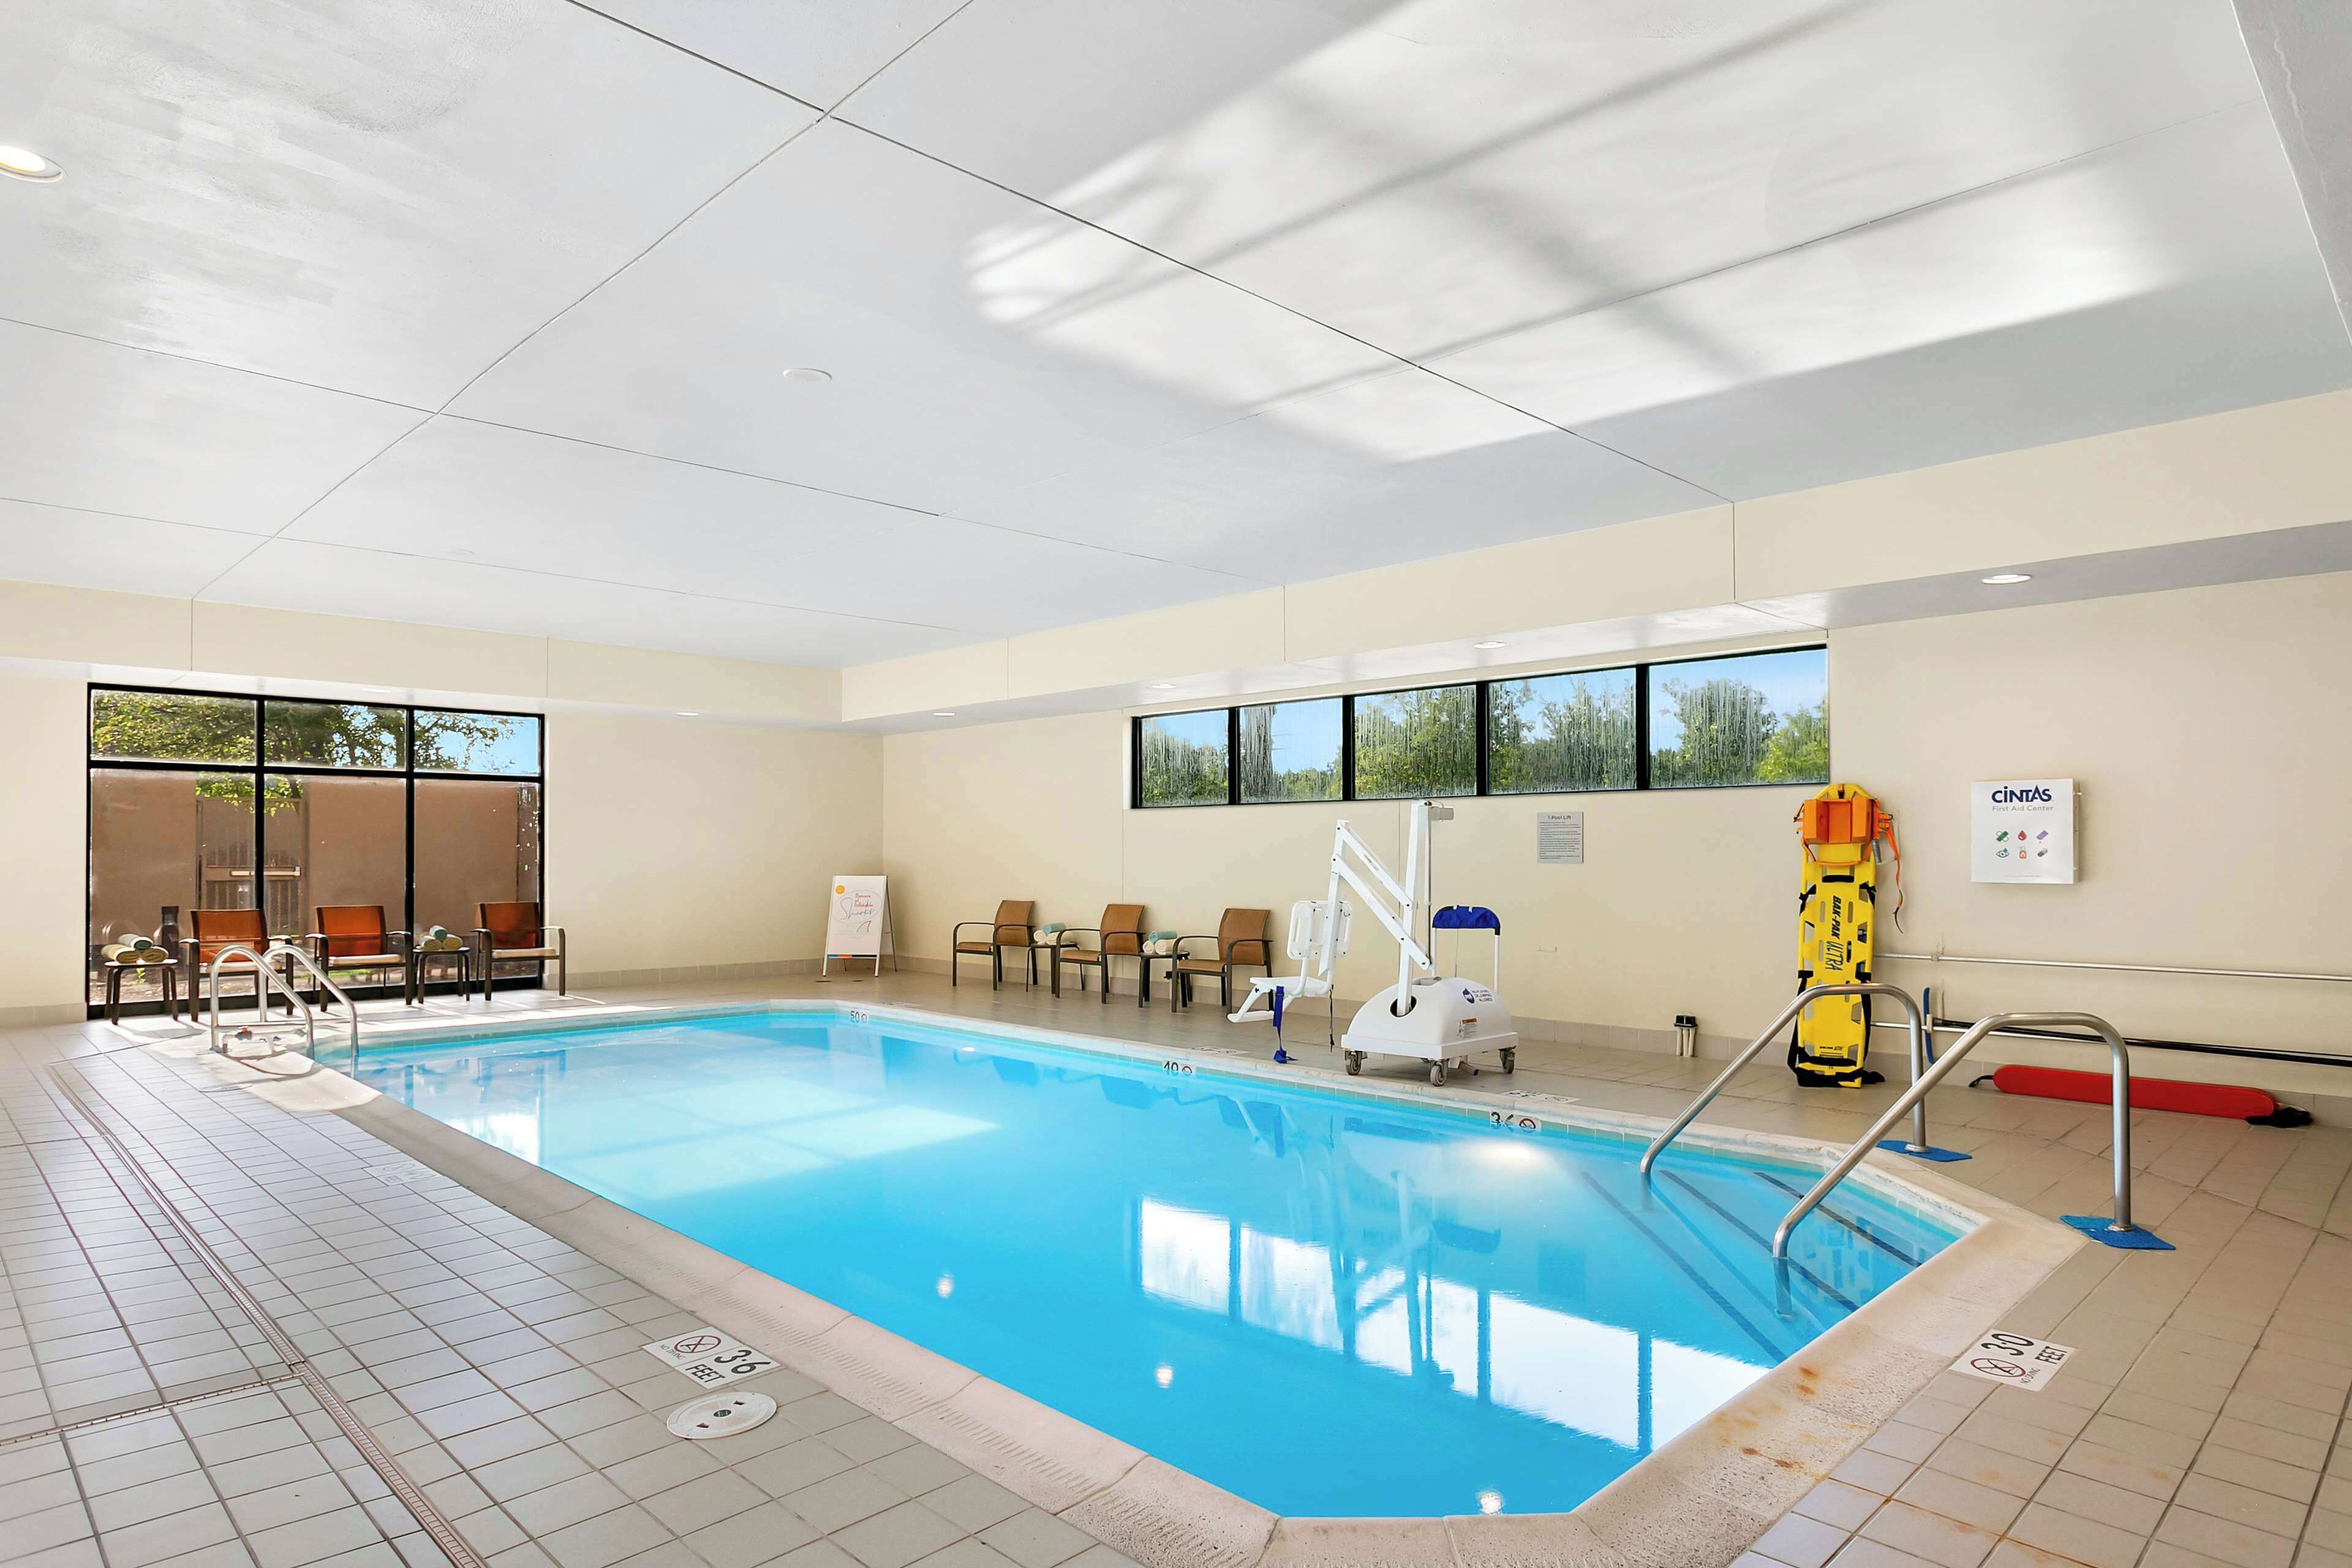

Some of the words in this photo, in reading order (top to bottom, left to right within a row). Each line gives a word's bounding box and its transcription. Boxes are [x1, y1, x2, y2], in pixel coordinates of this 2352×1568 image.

[1831, 895, 1841, 940] BAK-PAK
[1825, 941, 1844, 971] ULTRA
[2034, 1346, 2068, 1365] FEET
[685, 1363, 726, 1382] FEET
